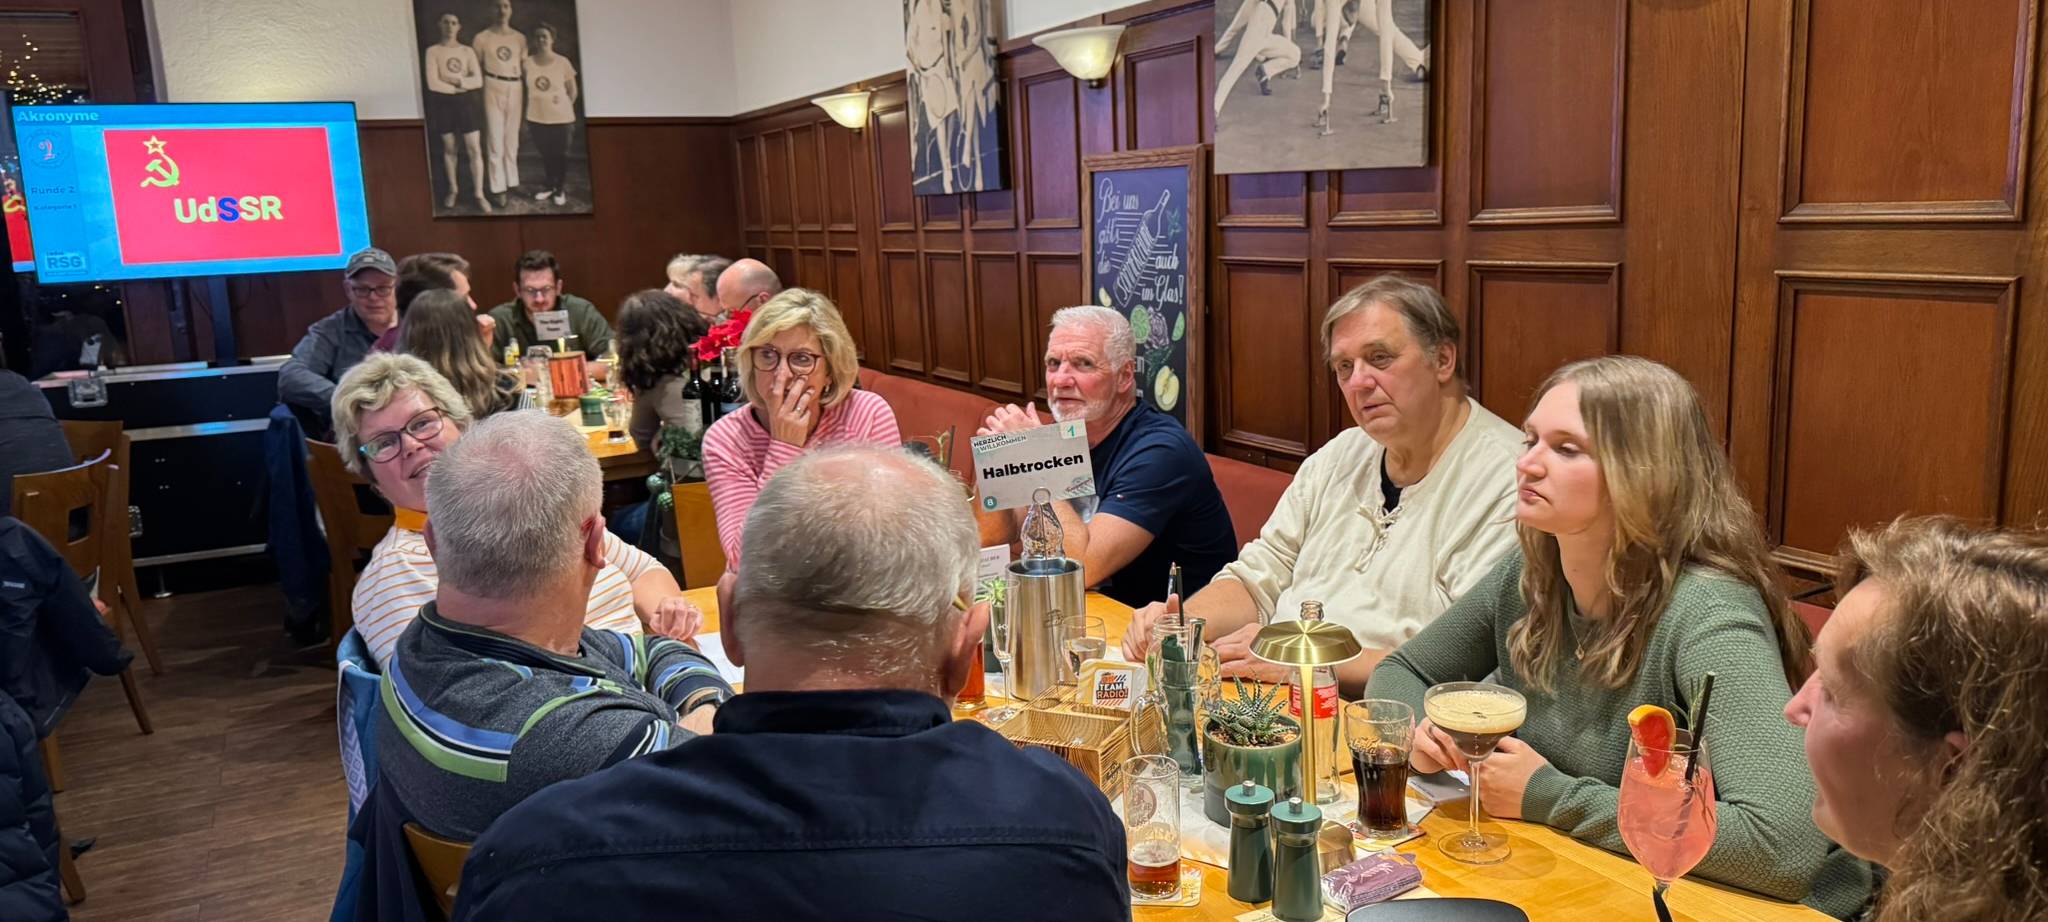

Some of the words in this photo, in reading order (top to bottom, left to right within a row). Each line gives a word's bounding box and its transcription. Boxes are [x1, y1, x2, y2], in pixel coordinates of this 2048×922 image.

[17, 111, 99, 123] Akronyme
[174, 196, 284, 224] UdSSR
[1123, 194, 1139, 210] uns
[47, 256, 83, 269] RSG
[1155, 243, 1180, 270] auch
[1154, 274, 1184, 311] Glas!
[974, 435, 1007, 447] HERZLICH
[980, 435, 1026, 451] WILLKOMMEN
[983, 454, 1084, 479] Halbtrocken
[1097, 689, 1128, 699] RADIO!
[1100, 683, 1122, 691] TEAM
